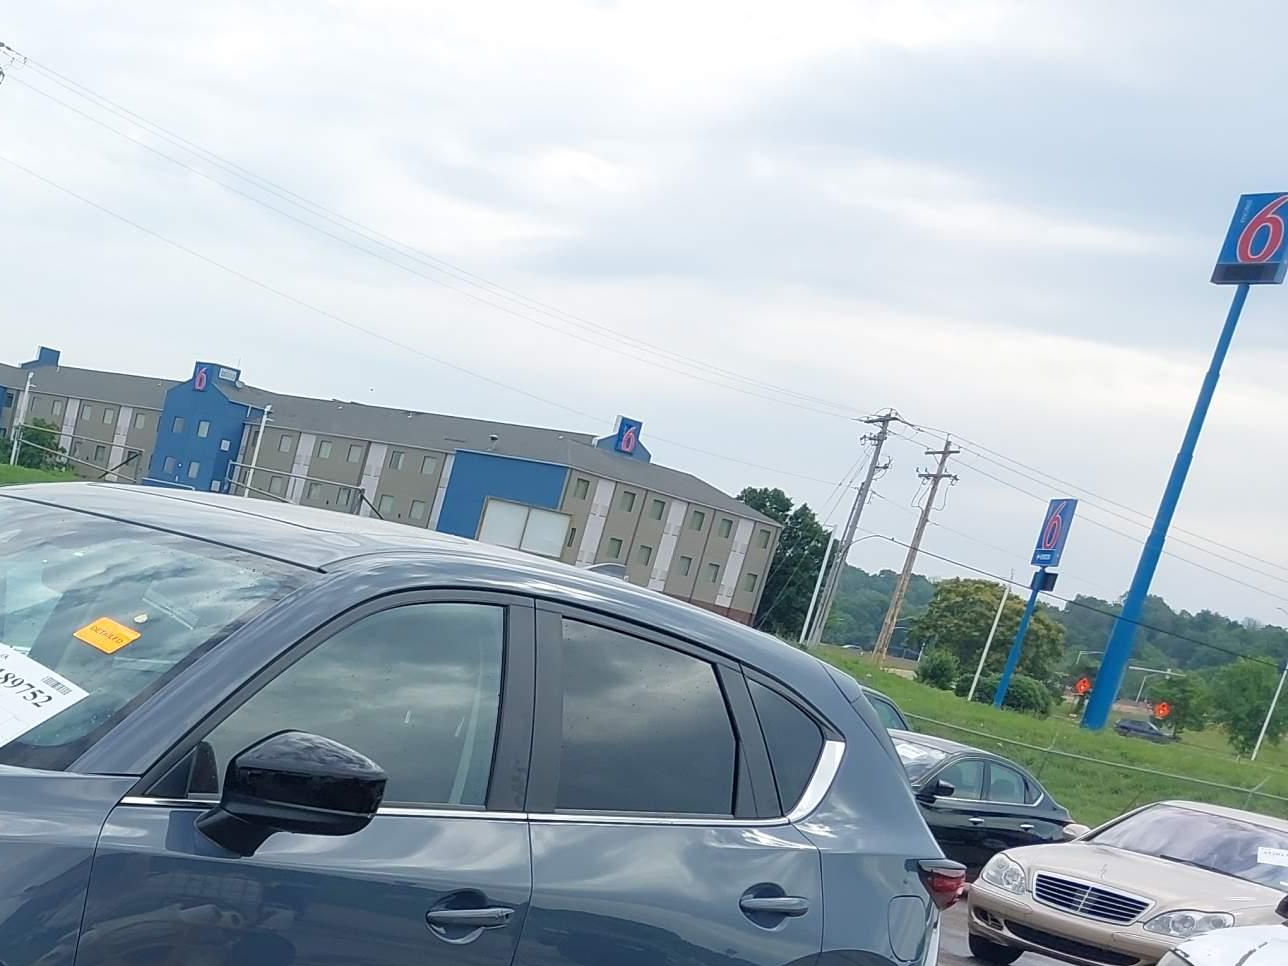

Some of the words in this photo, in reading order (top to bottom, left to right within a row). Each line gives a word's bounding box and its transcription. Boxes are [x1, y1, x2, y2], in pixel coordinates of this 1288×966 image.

[1236, 194, 1288, 263] 6
[195, 367, 208, 391] 6
[621, 426, 637, 453] 6
[1042, 501, 1066, 550] 6
